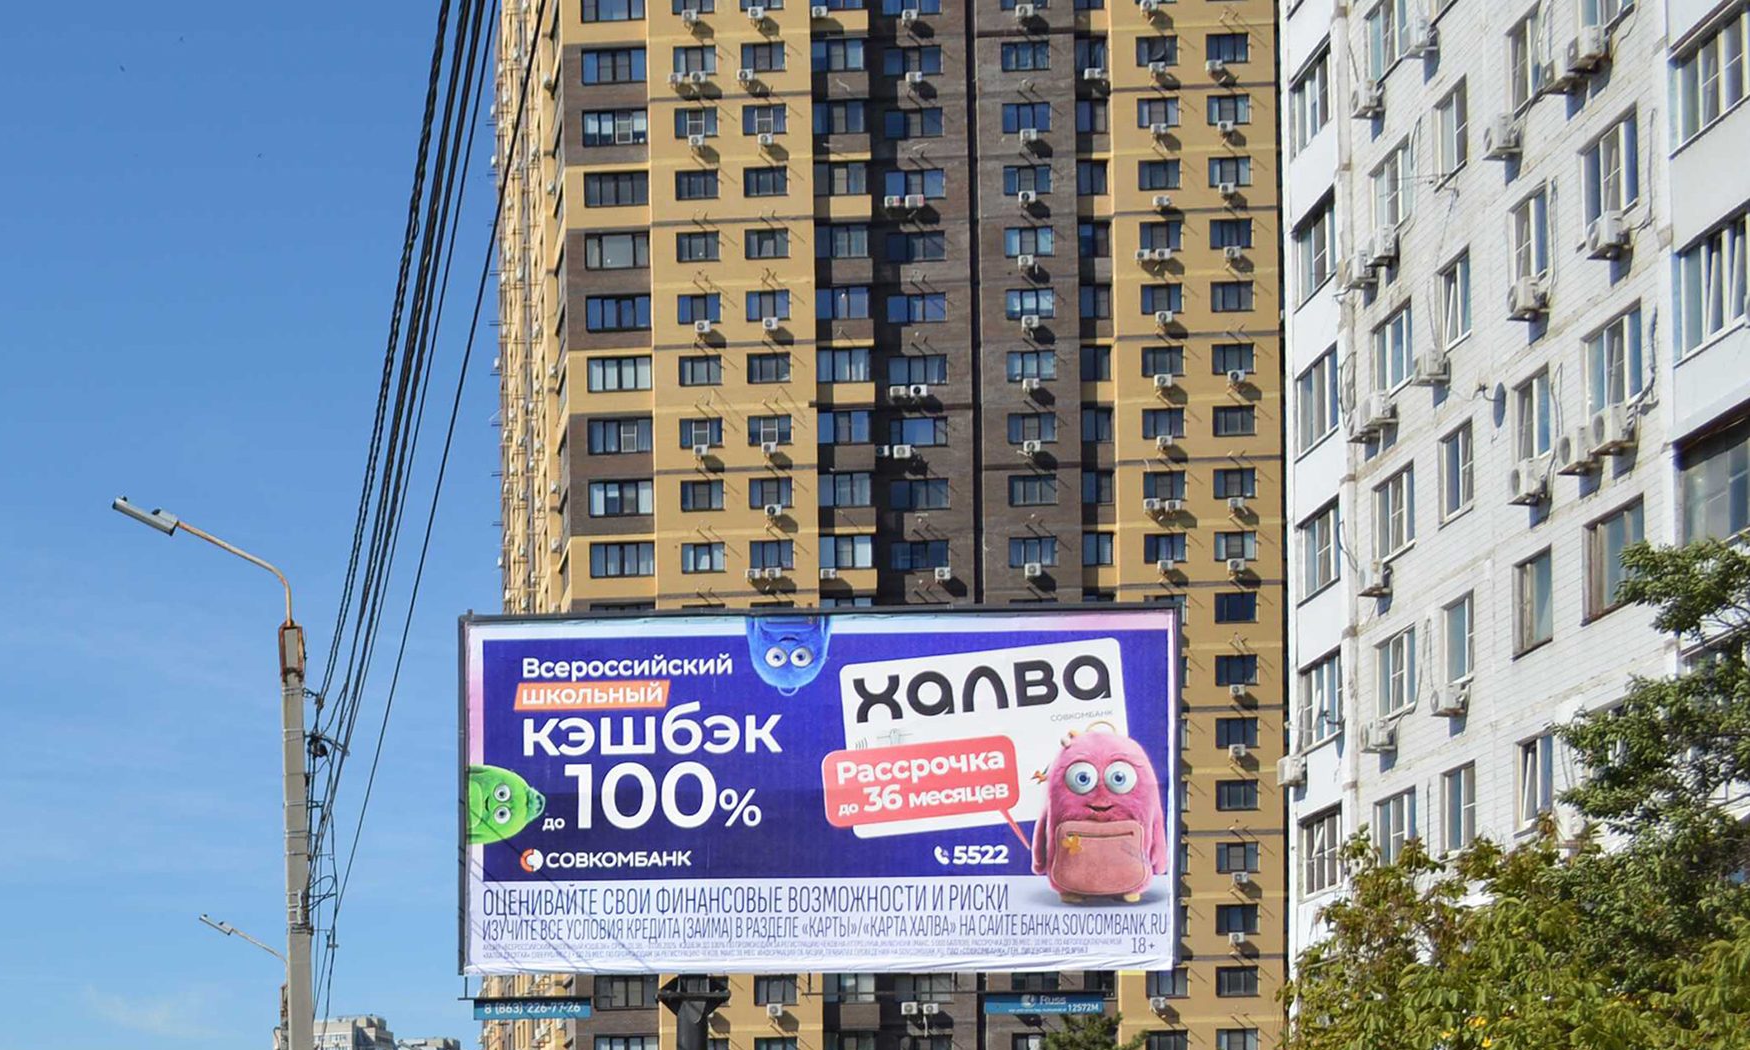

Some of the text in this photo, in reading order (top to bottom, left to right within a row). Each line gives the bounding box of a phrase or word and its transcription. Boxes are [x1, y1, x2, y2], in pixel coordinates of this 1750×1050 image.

[522, 654, 733, 681] Всероссийский
[522, 682, 663, 705] школьный
[523, 701, 783, 756] кэшбэк
[836, 750, 1006, 784] Рассрочка
[542, 761, 762, 831] до 100%
[838, 782, 1009, 817] до 36 месяцев
[546, 850, 692, 868] СОВКОМБАНК
[953, 844, 1009, 865] 5522
[483, 883, 1009, 918] ОЦЕНИВАЙТЕ СВОИ ФИНАНСОВЫЕ ВОЗМОЖНОСТИ И РИСКИ
[483, 919, 537, 941] ИЗУЧИТЕ
[540, 919, 563, 940] ВСЕ
[567, 918, 624, 940] УСЛОВИЯ
[627, 918, 680, 942] КРЕДИТА
[682, 914, 733, 943] (ЗАЙМА)
[736, 918, 743, 939] В
[745, 917, 799, 942] РАЗДЕЛЕ
[910, 915, 956, 937] ХАЛВА»
[959, 914, 977, 936] НА
[978, 911, 1018, 937] САЙТЕ
[1020, 914, 1060, 936] БАНКА
[1062, 913, 1167, 936] SOVCOMBANK.RU
[1131, 936, 1156, 954] 18+
[484, 1002, 581, 1015] 8 (863) 226-77-26
